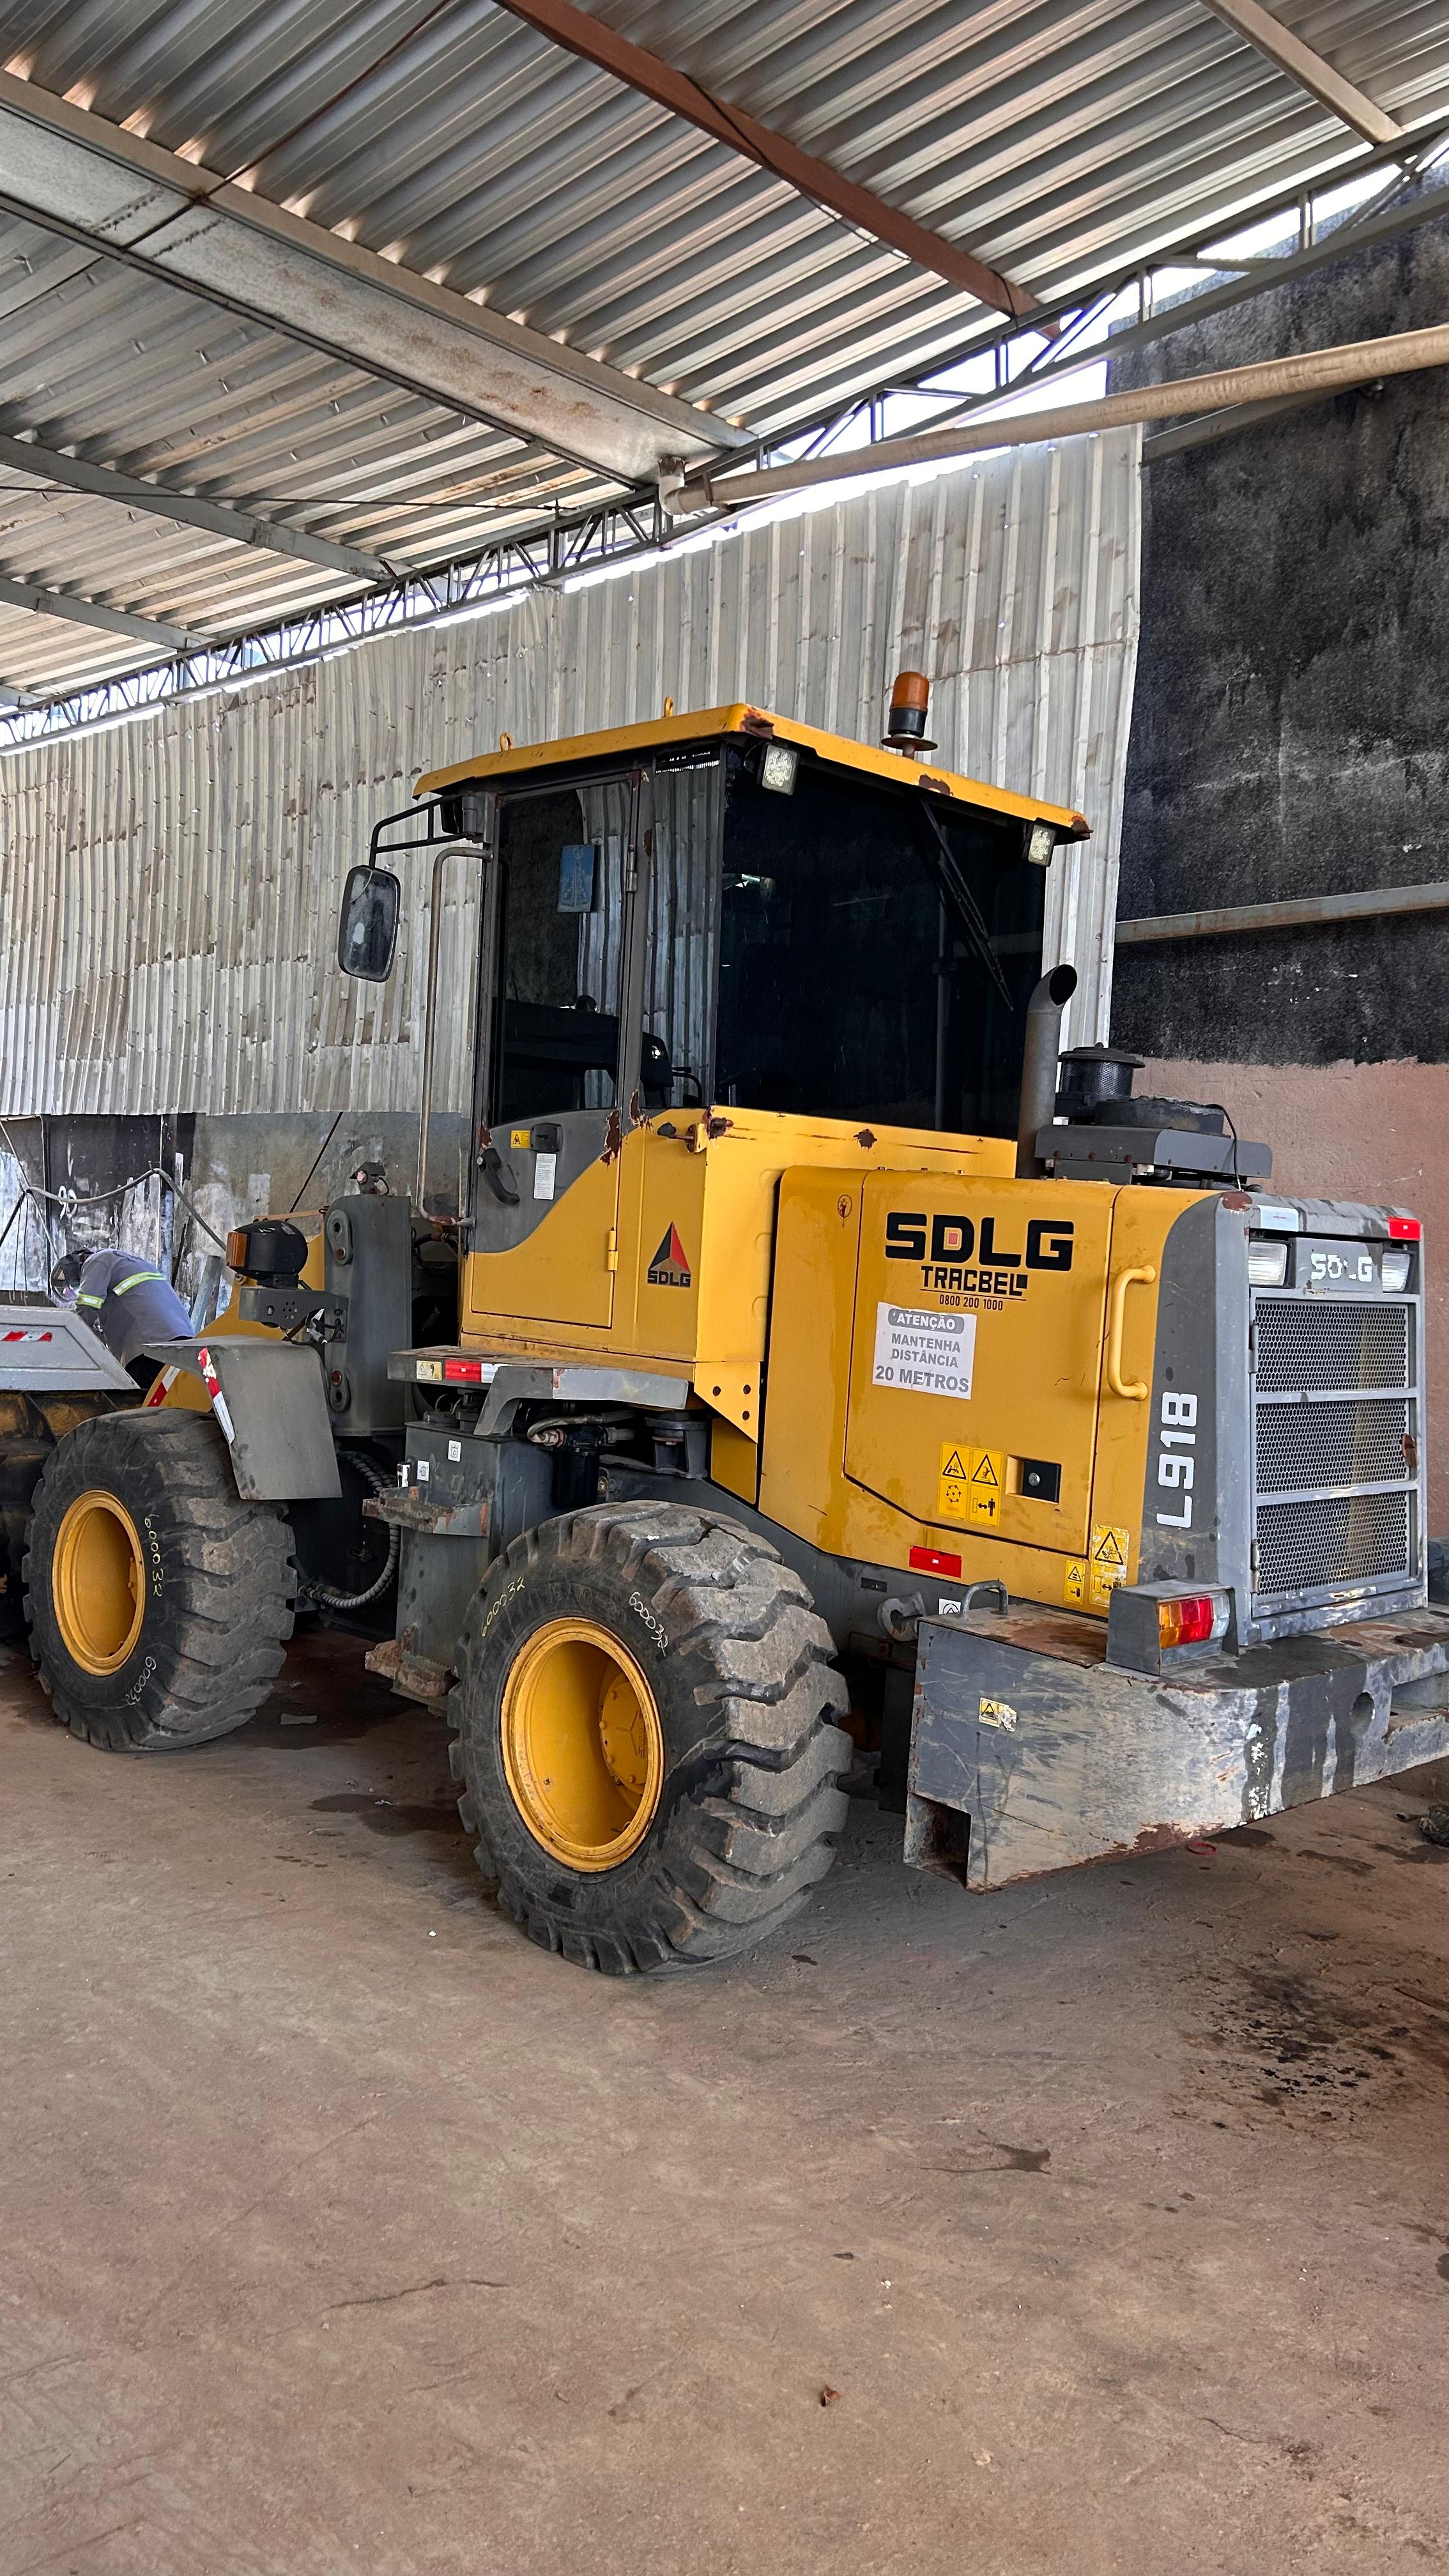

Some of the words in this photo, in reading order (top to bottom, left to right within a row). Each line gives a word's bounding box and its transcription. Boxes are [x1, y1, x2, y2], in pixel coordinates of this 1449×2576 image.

[885, 1212, 1074, 1271] SDLG
[647, 1270, 691, 1287] SDLG
[921, 1265, 1026, 1297] TRACBEL
[939, 1294, 960, 1307] 0800
[963, 1297, 979, 1308] 200
[983, 1298, 1004, 1311] 1000
[896, 1312, 956, 1331] ATENÇÃO
[891, 1333, 961, 1353] MANTENHA
[891, 1348, 958, 1368] DISTÂNCIA
[875, 1365, 894, 1381] 20
[900, 1368, 970, 1393] METROS
[1156, 1392, 1198, 1528] L918
